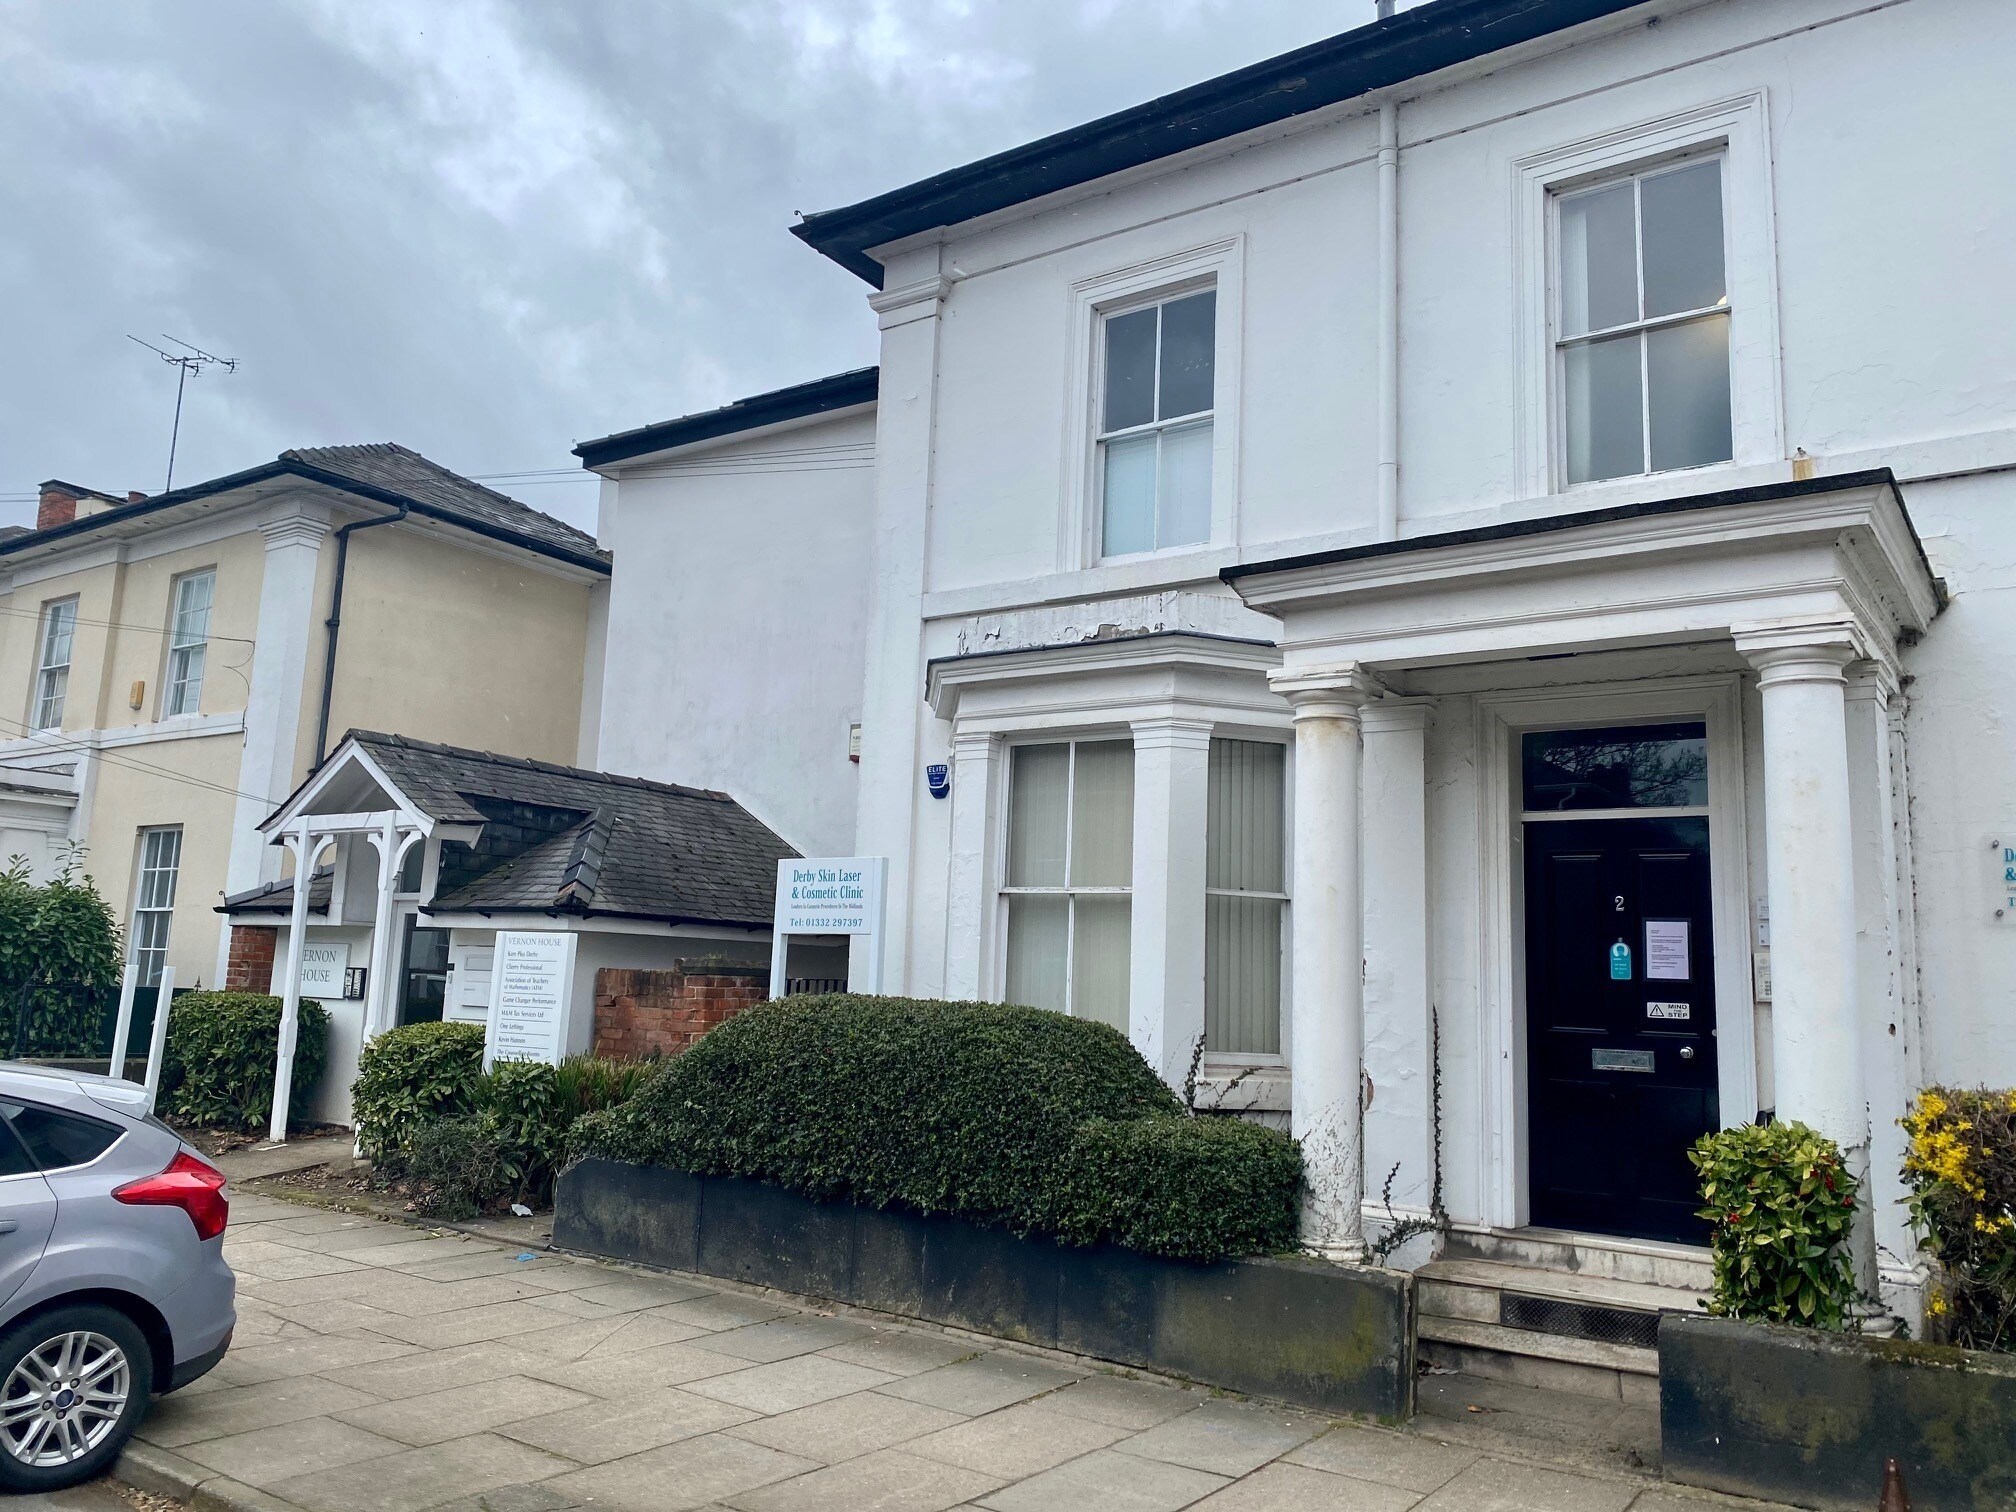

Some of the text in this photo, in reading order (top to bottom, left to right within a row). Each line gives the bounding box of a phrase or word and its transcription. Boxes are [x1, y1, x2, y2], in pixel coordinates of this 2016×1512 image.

[793, 868, 862, 886] Derby Skin Laser
[791, 885, 864, 899] & Cosmetic Clinic
[1615, 896, 1624, 911] 2
[790, 918, 863, 927] Tel: 01332 297397
[508, 937, 562, 947] VERNON HOUSE
[303, 949, 337, 962] ERNON
[509, 1023, 524, 1031] Lettings
